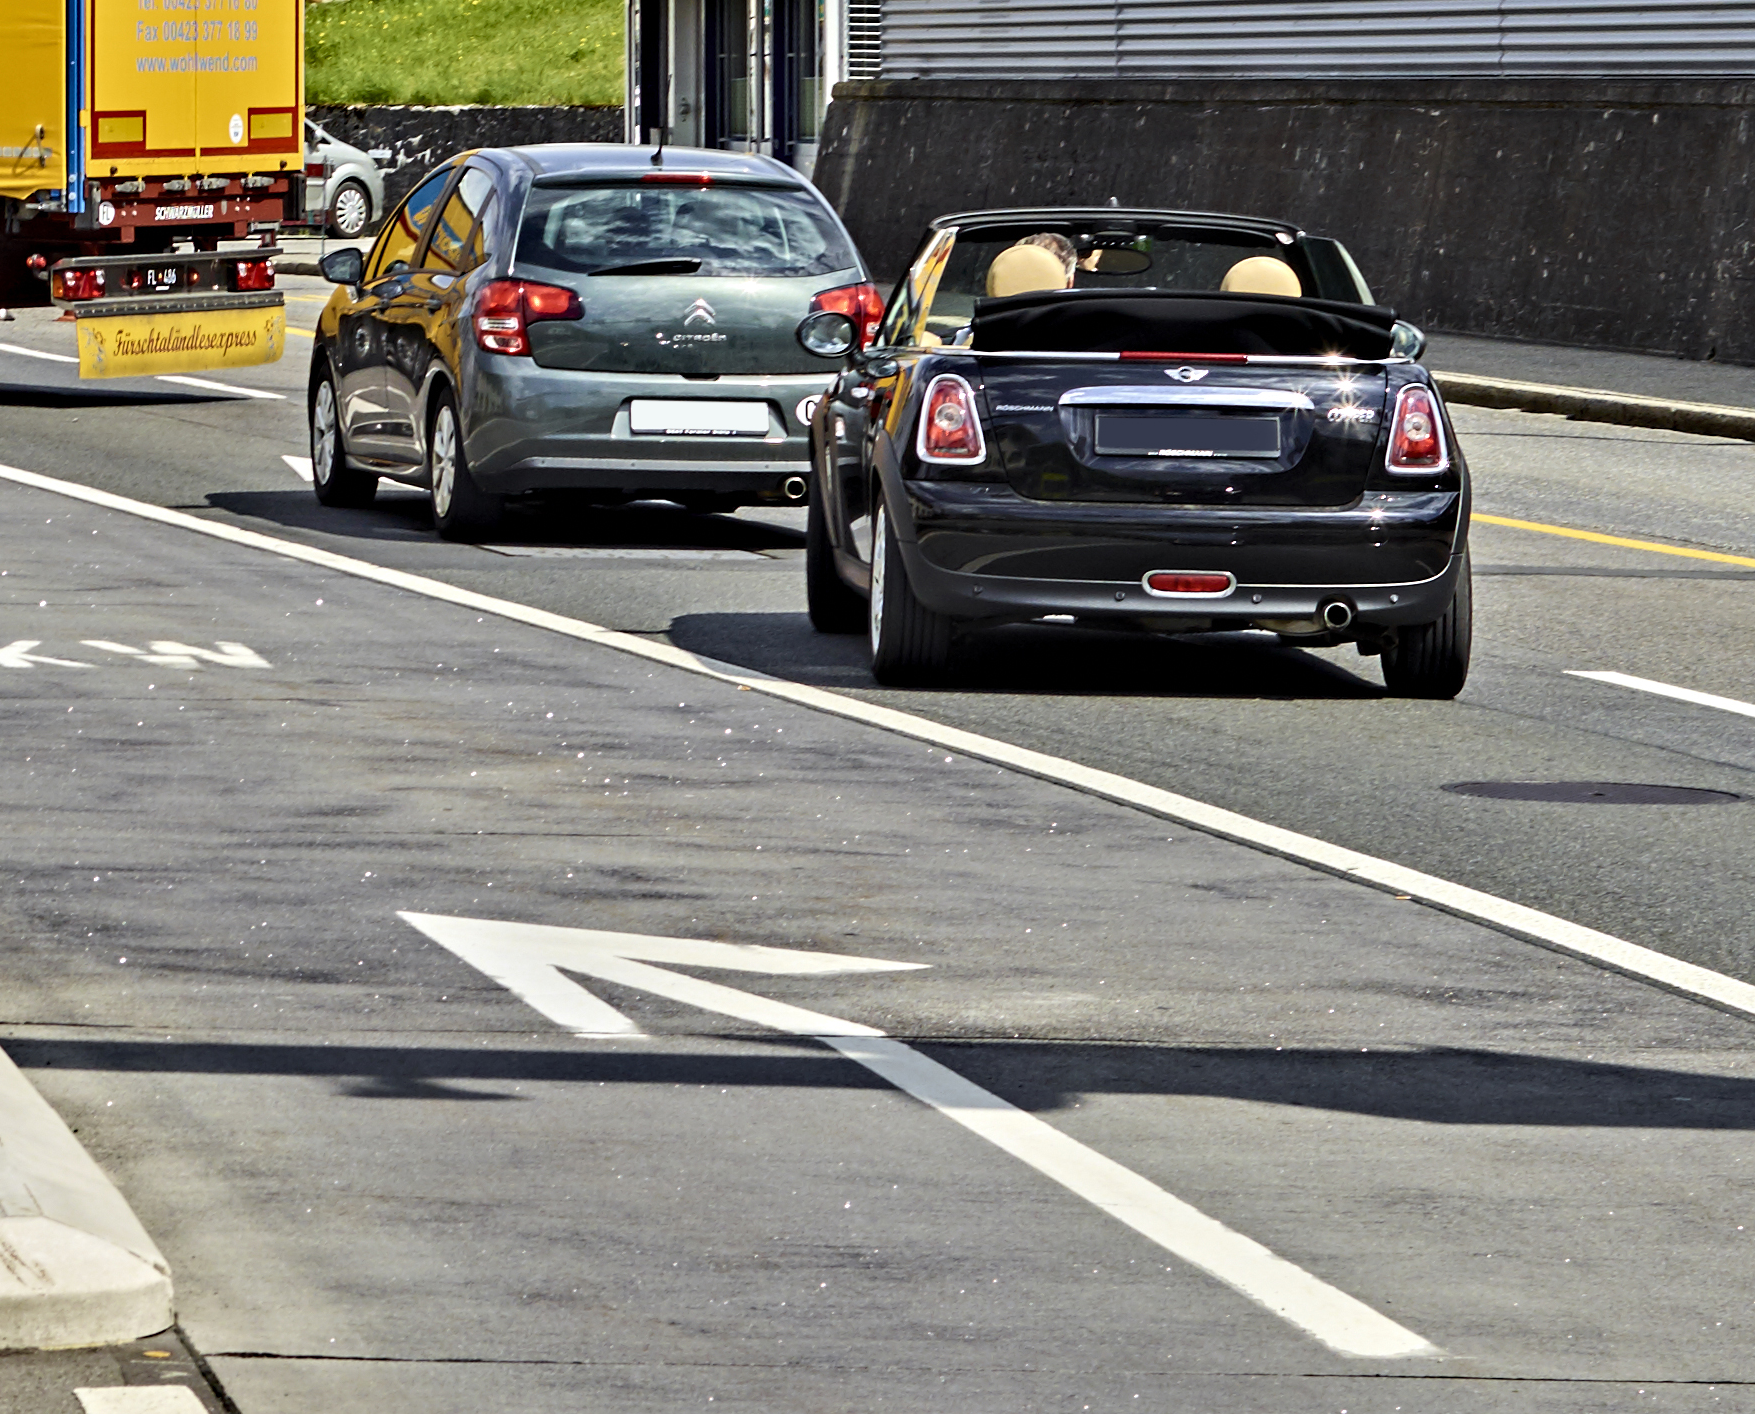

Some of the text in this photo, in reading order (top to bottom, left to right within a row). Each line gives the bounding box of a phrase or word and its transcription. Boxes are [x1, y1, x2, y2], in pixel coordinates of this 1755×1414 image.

[136, 20, 158, 41] Fax
[162, 20, 199, 42] 00423
[202, 20, 223, 41] 377
[136, 51, 258, 73] www.wohlwend.com
[102, 206, 111, 220] FL
[147, 269, 157, 285] FL
